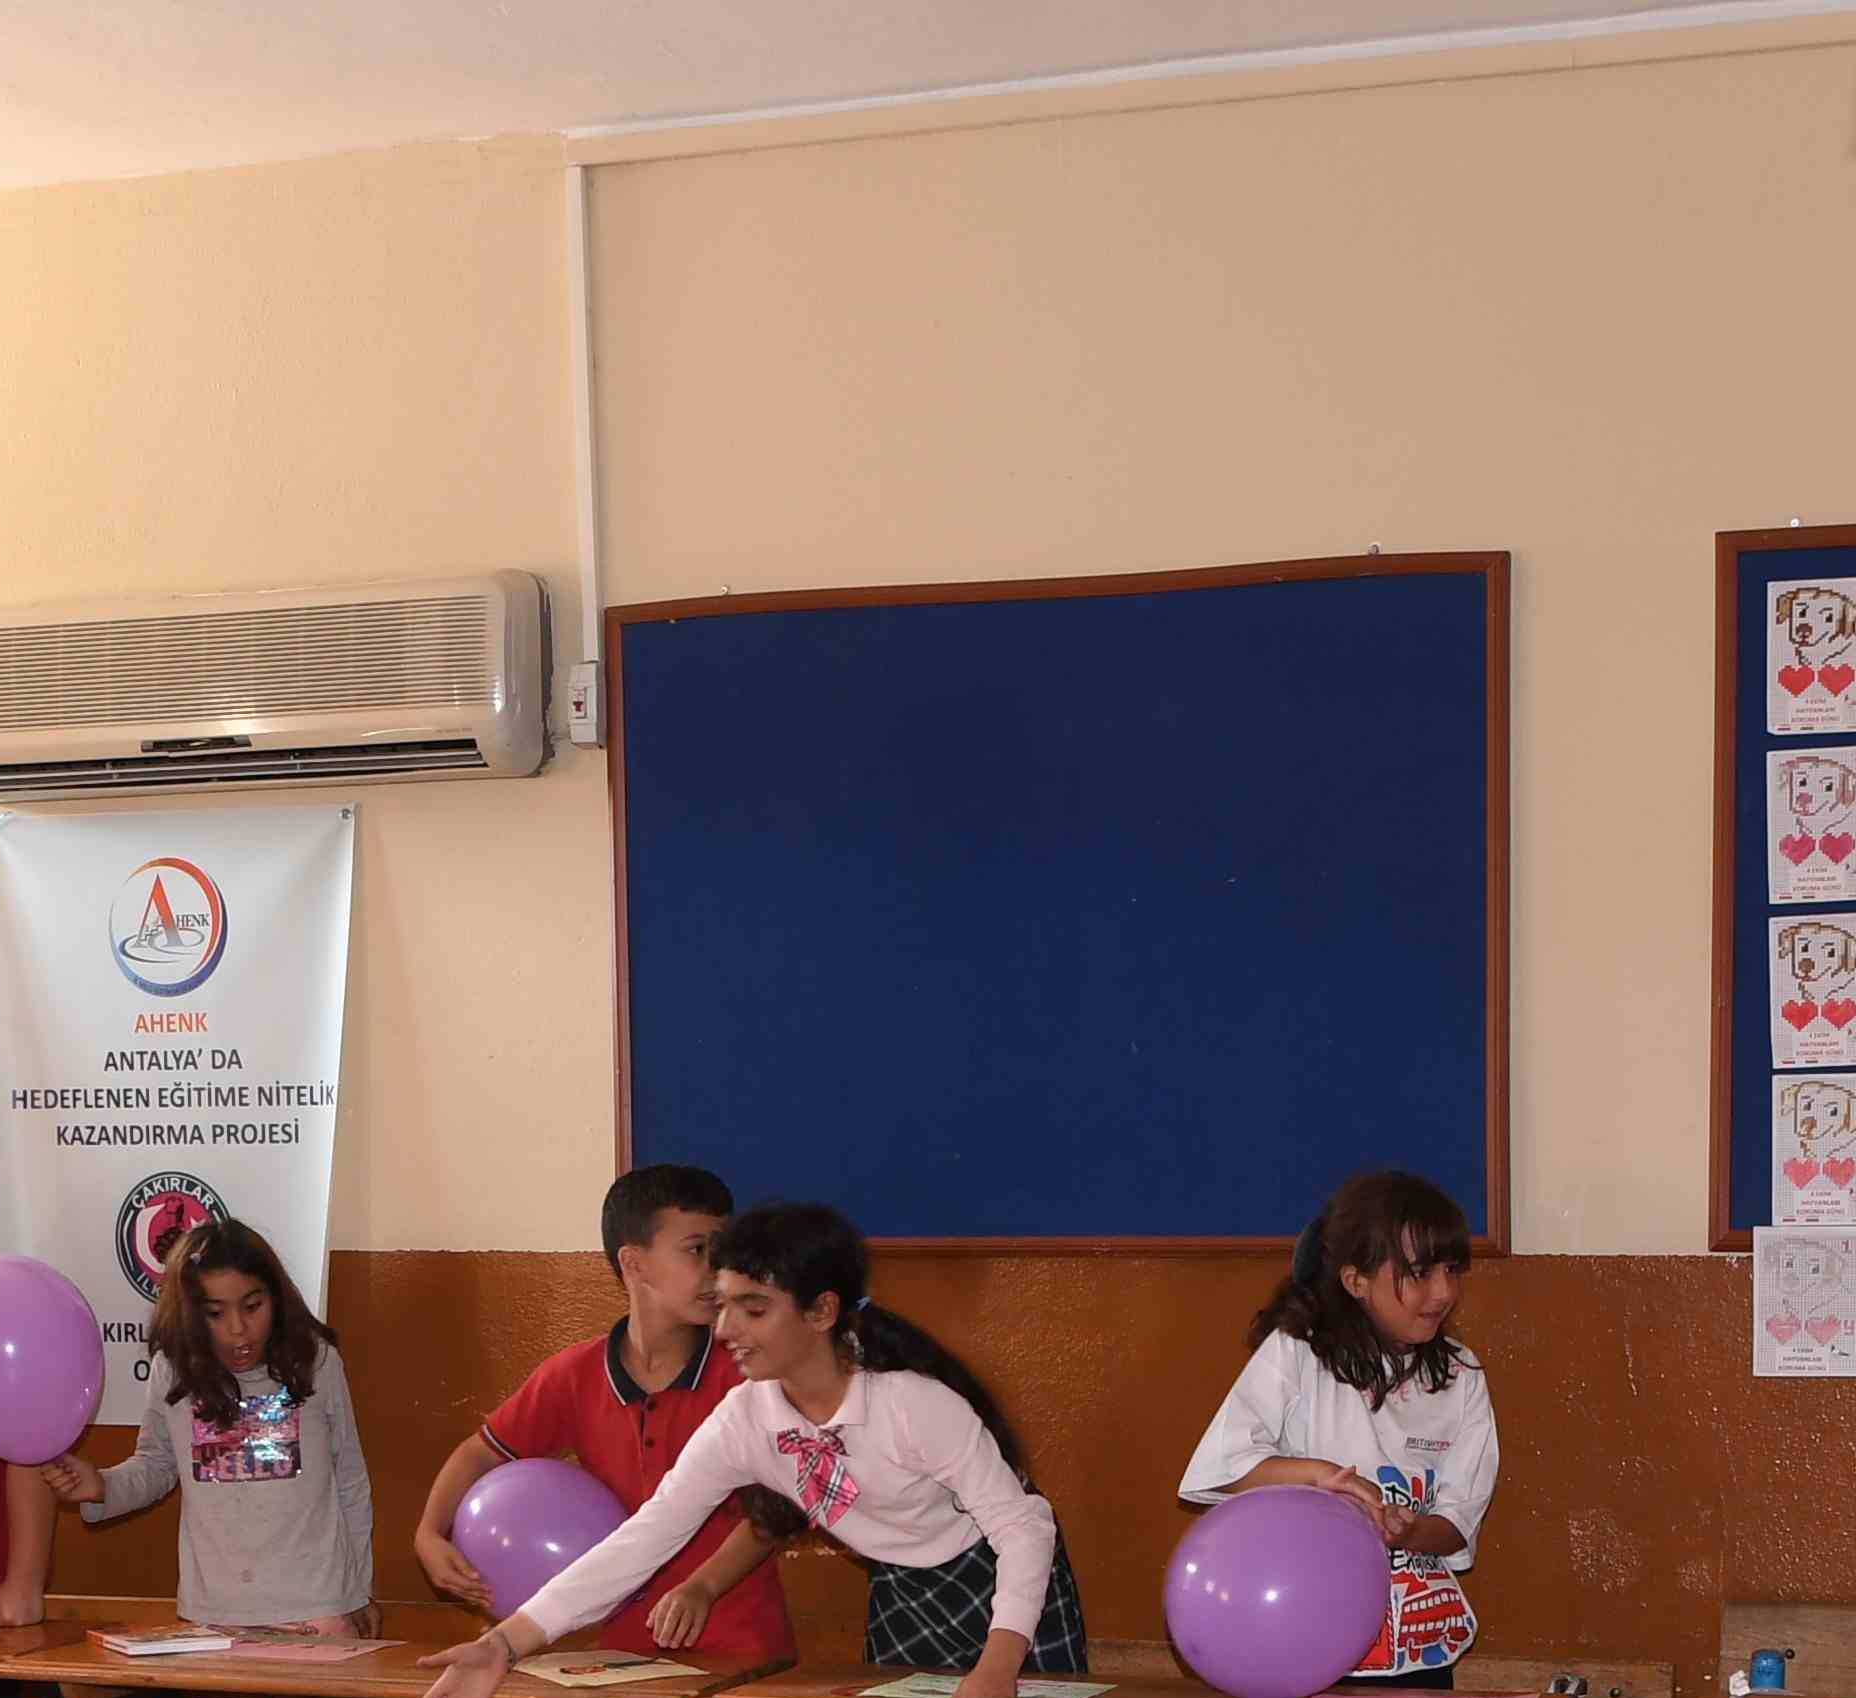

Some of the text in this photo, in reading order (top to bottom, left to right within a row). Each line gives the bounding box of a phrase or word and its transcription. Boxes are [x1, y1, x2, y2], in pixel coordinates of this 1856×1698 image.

[134, 1012, 209, 1033] AHENK
[210, 1048, 243, 1070] DA
[11, 1080, 335, 1110] HEDEFLENEN EĞİTİME NİTELİK
[56, 1118, 300, 1146] KAZANDIRMA PROJESİ
[131, 1177, 215, 1209] ÇAKIRLAR
